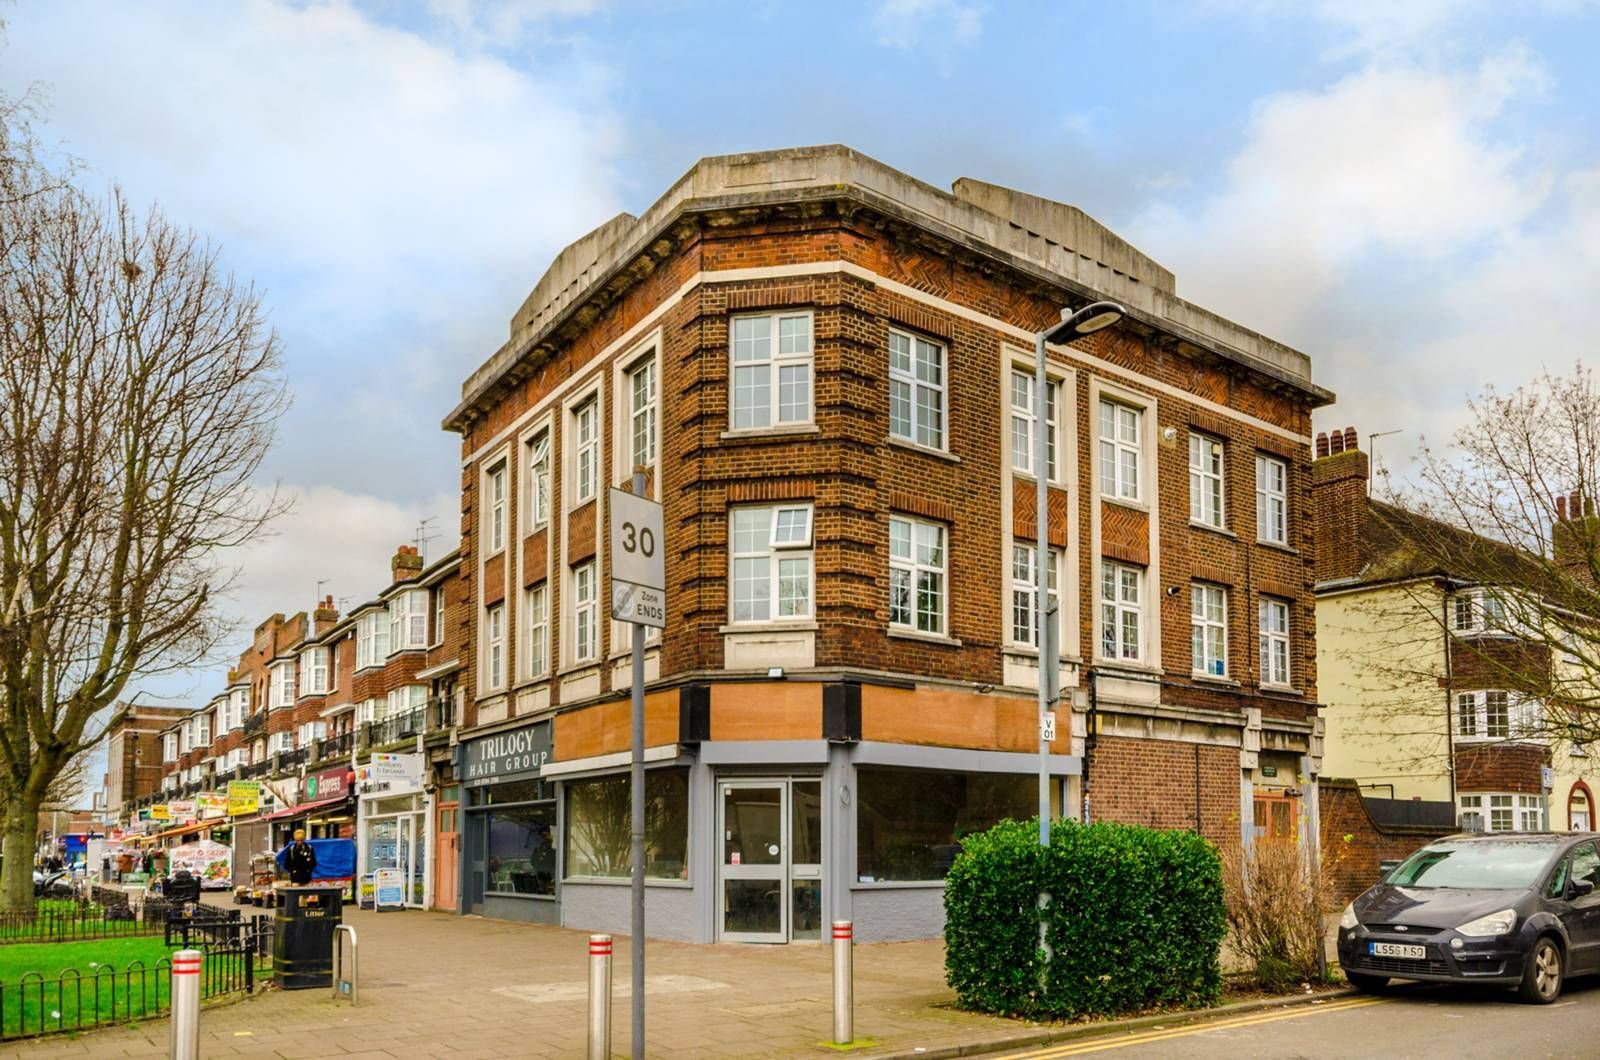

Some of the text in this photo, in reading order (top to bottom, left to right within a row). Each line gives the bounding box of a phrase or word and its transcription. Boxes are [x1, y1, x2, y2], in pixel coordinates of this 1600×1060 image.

[622, 521, 655, 558] 30
[641, 591, 659, 604] Zone
[637, 603, 663, 621] ENDS
[1045, 719, 1051, 728] V
[480, 729, 534, 760] TRILOGY
[469, 752, 547, 778] HAIR GROUP
